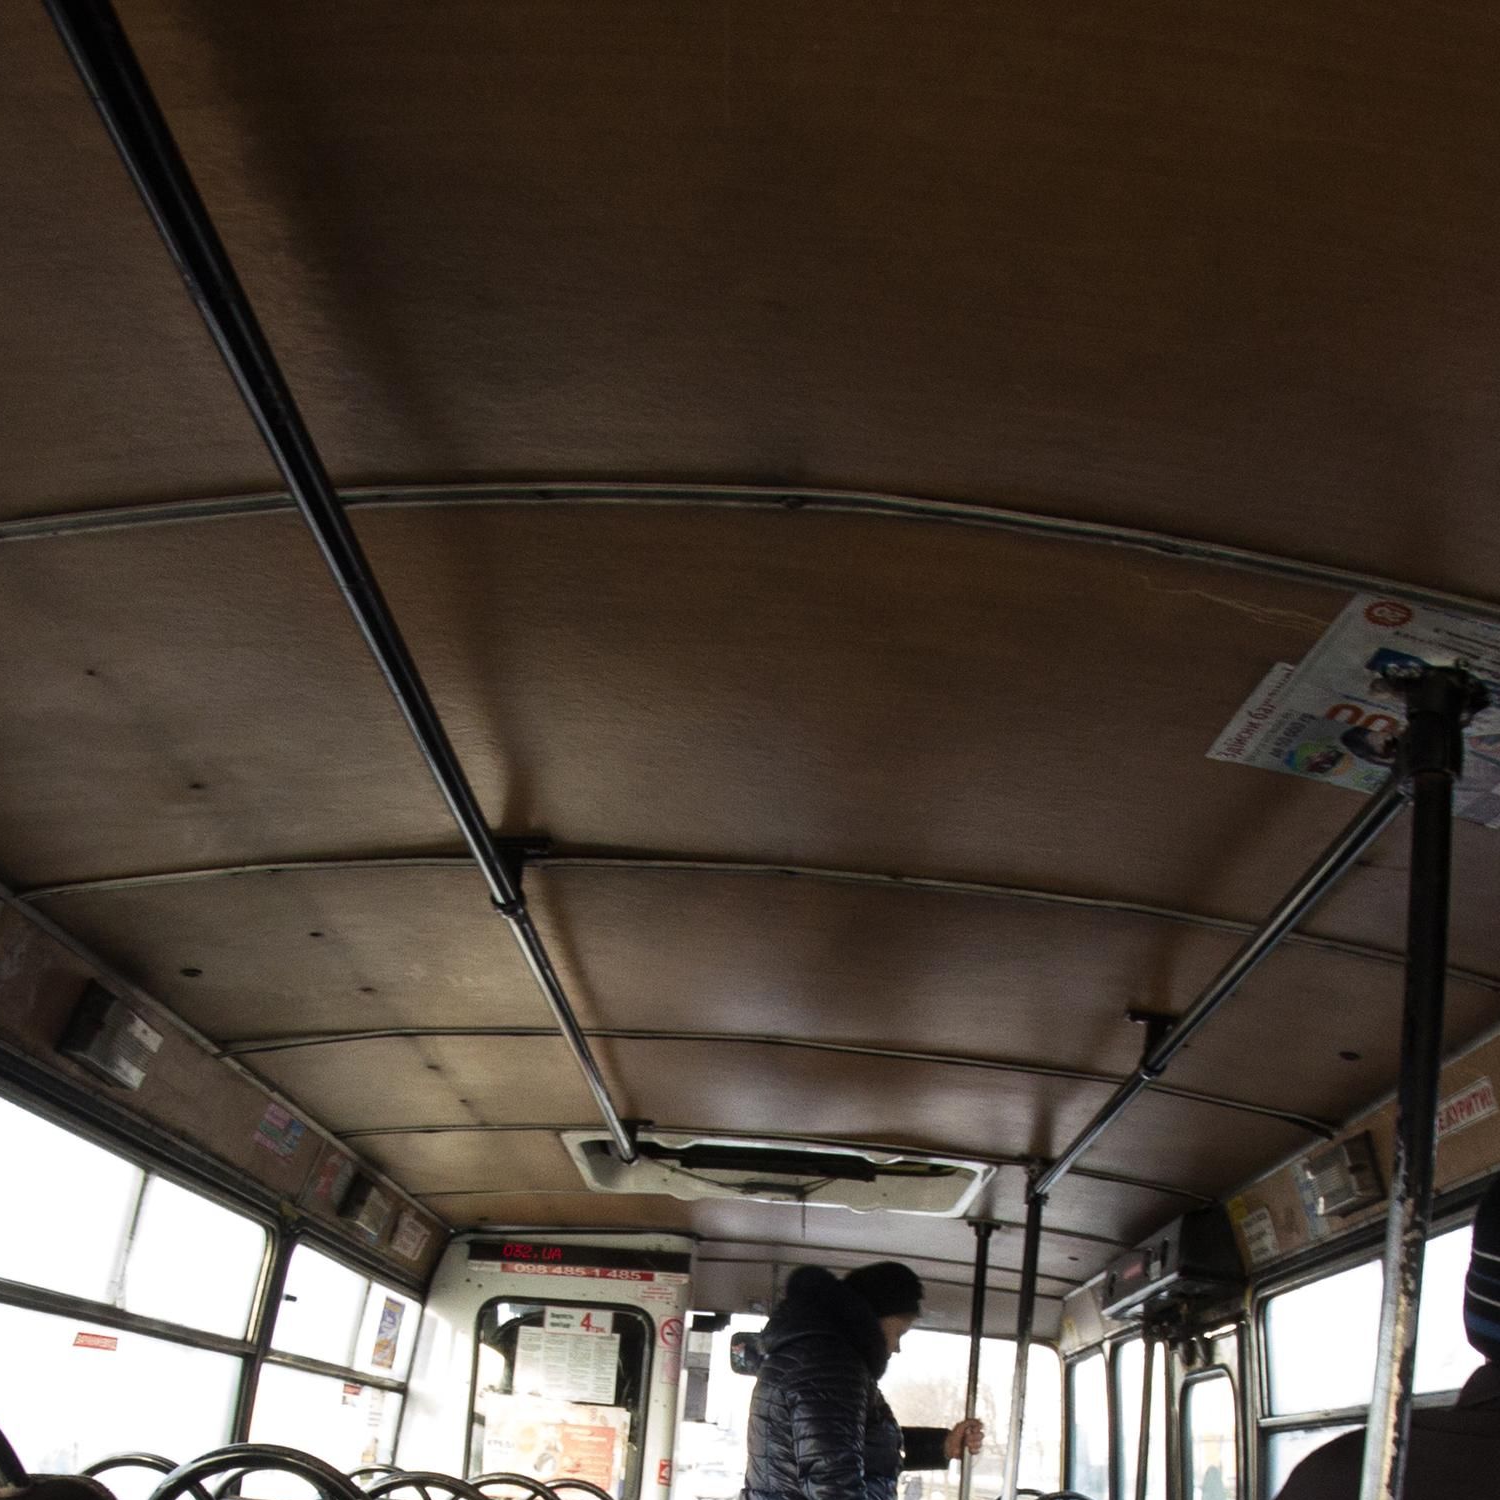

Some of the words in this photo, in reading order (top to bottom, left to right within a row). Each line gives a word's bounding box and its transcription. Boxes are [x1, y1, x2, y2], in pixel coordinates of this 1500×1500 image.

[502, 1244, 563, 1260] 032.UA
[514, 1263, 548, 1274] 098
[551, 1266, 586, 1277] 485
[592, 1268, 601, 1277] 1
[606, 1270, 642, 1281] 485
[580, 1311, 592, 1331] 4
